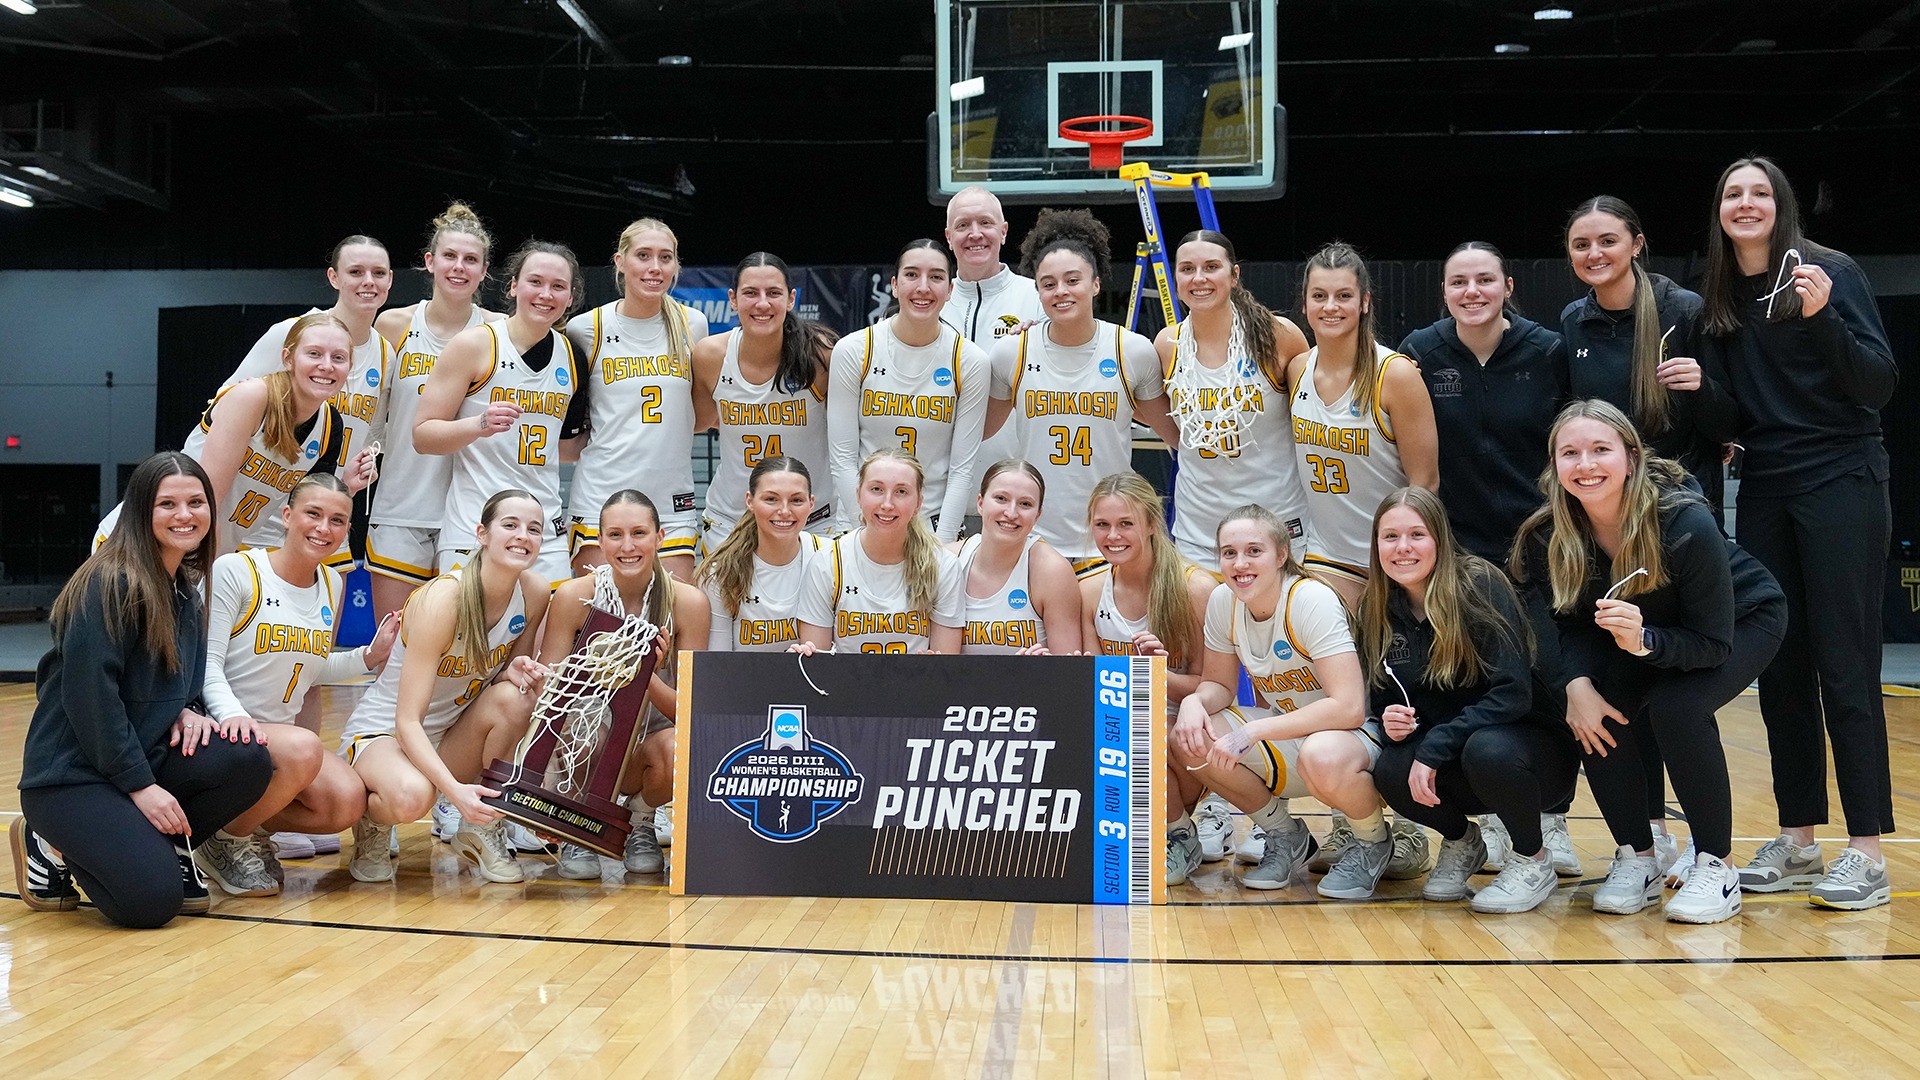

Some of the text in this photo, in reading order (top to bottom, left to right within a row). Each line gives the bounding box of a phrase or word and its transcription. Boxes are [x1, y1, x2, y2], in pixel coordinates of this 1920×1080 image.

[800, 304, 819, 312] WIN
[1158, 279, 1175, 325] BASKETBALL
[602, 355, 691, 385] OSHKOSH
[327, 391, 378, 426] HKOSH
[641, 385, 662, 423] 2
[719, 399, 807, 426] OSHKOSH
[862, 389, 955, 423] OSHKOSH
[1025, 390, 1118, 421] OSHKOSH
[518, 424, 548, 466] 12
[742, 435, 784, 468] 24
[895, 426, 917, 457] 3
[1049, 425, 1092, 466] 34
[1293, 415, 1369, 456] SHKOSH
[1306, 454, 1349, 494] 33
[229, 490, 270, 529] 10
[740, 617, 800, 645] OSHK
[837, 610, 930, 638] OSHKOSH
[962, 620, 1037, 648] HKOSH
[254, 623, 332, 660] OSHKOS
[282, 663, 304, 703] 1
[1099, 669, 1127, 709] 26
[943, 706, 1038, 732] 2026
[1105, 714, 1120, 743] SEAT
[731, 766, 840, 776] WOMEN'S BASKETBALL
[748, 755, 825, 765] 2026 DIII
[906, 739, 1056, 783] TICKET
[1099, 747, 1127, 778] 19
[713, 777, 858, 798] CHAMPIONSHIP
[1104, 785, 1120, 813] ROW
[511, 792, 602, 834] SECTIONAL CHAMPION
[872, 786, 1082, 832] PUNCHED
[1099, 819, 1127, 840] 3
[1104, 843, 1120, 895] SECTION
